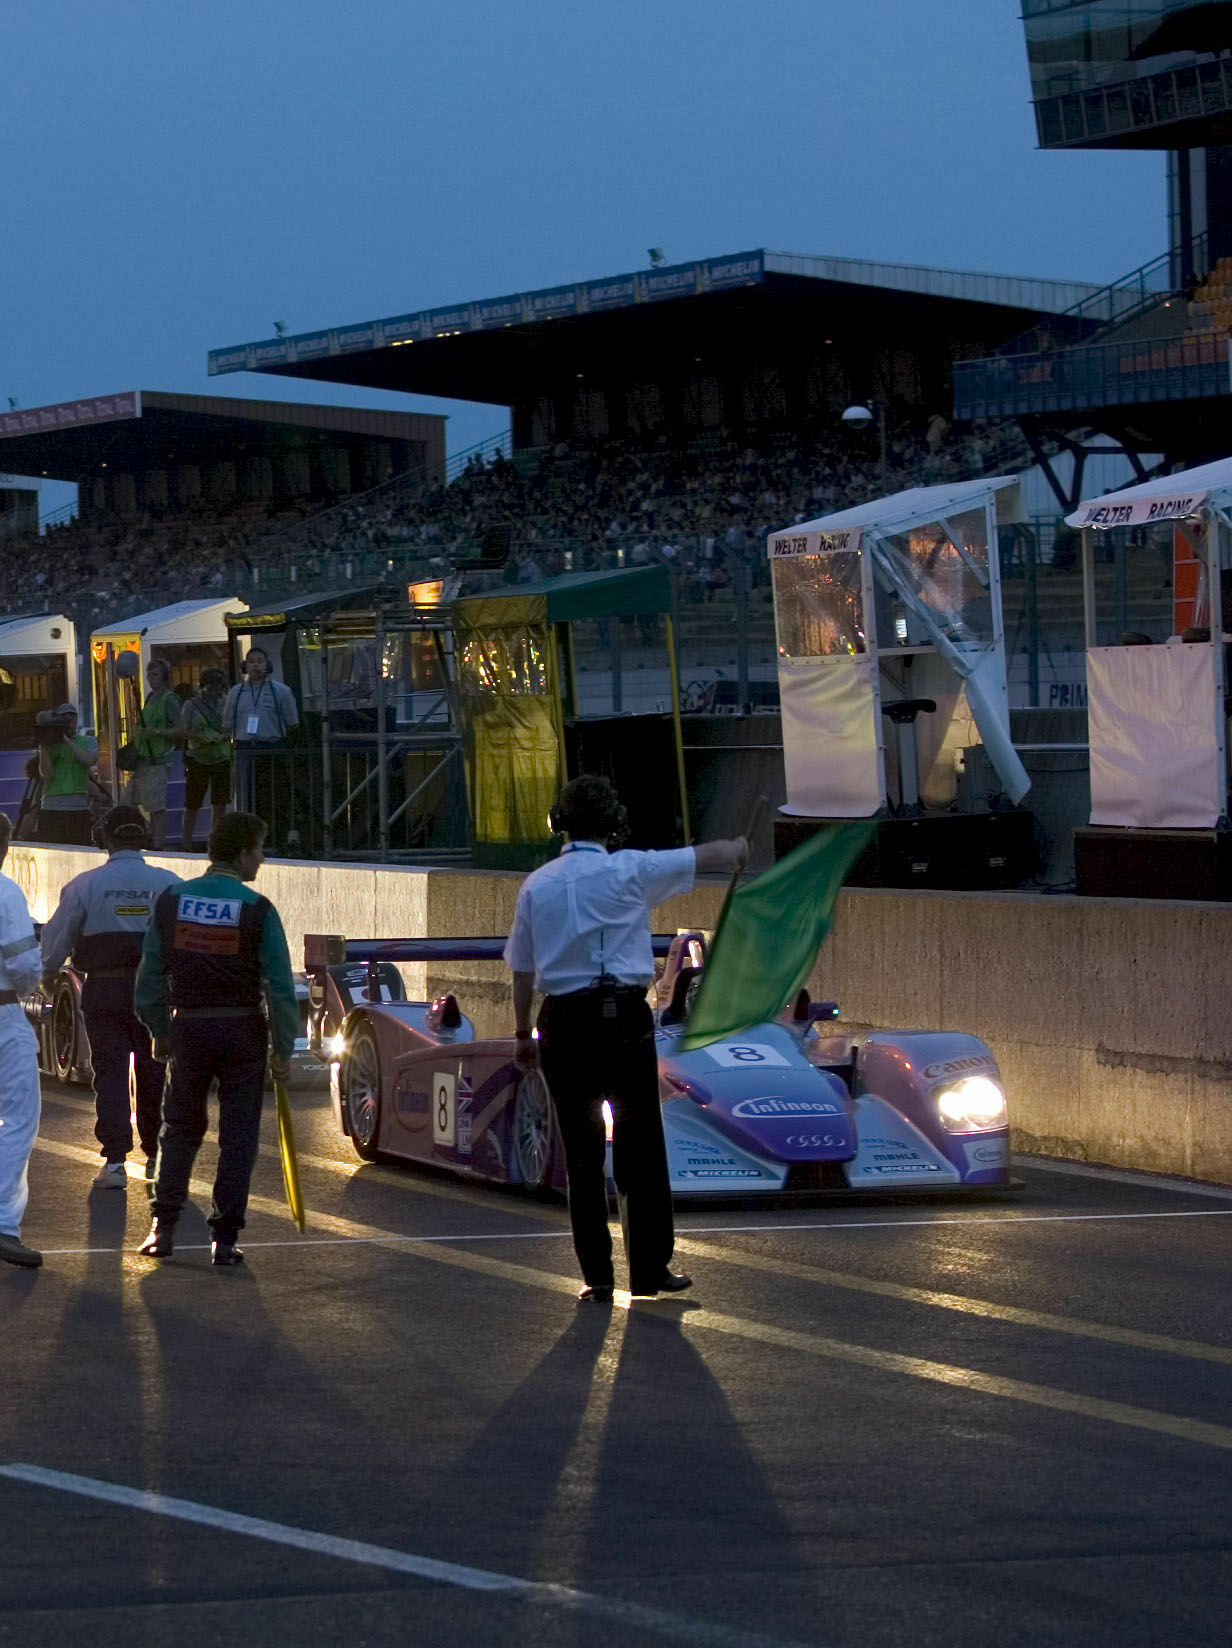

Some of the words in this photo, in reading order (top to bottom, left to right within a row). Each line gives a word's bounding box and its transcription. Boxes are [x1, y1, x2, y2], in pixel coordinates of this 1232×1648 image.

[711, 259, 760, 279] MICHELIN
[1083, 505, 1133, 523] WELTER
[1146, 498, 1194, 520] RACING
[774, 537, 808, 555] WELTER
[104, 890, 150, 899] FFSA
[729, 1047, 766, 1062] 8
[924, 1055, 994, 1079] Canon
[438, 1085, 448, 1132] 8
[748, 1099, 838, 1115] Infineon
[873, 1152, 920, 1161] MAHLE
[696, 1169, 759, 1177] MICHELIN
